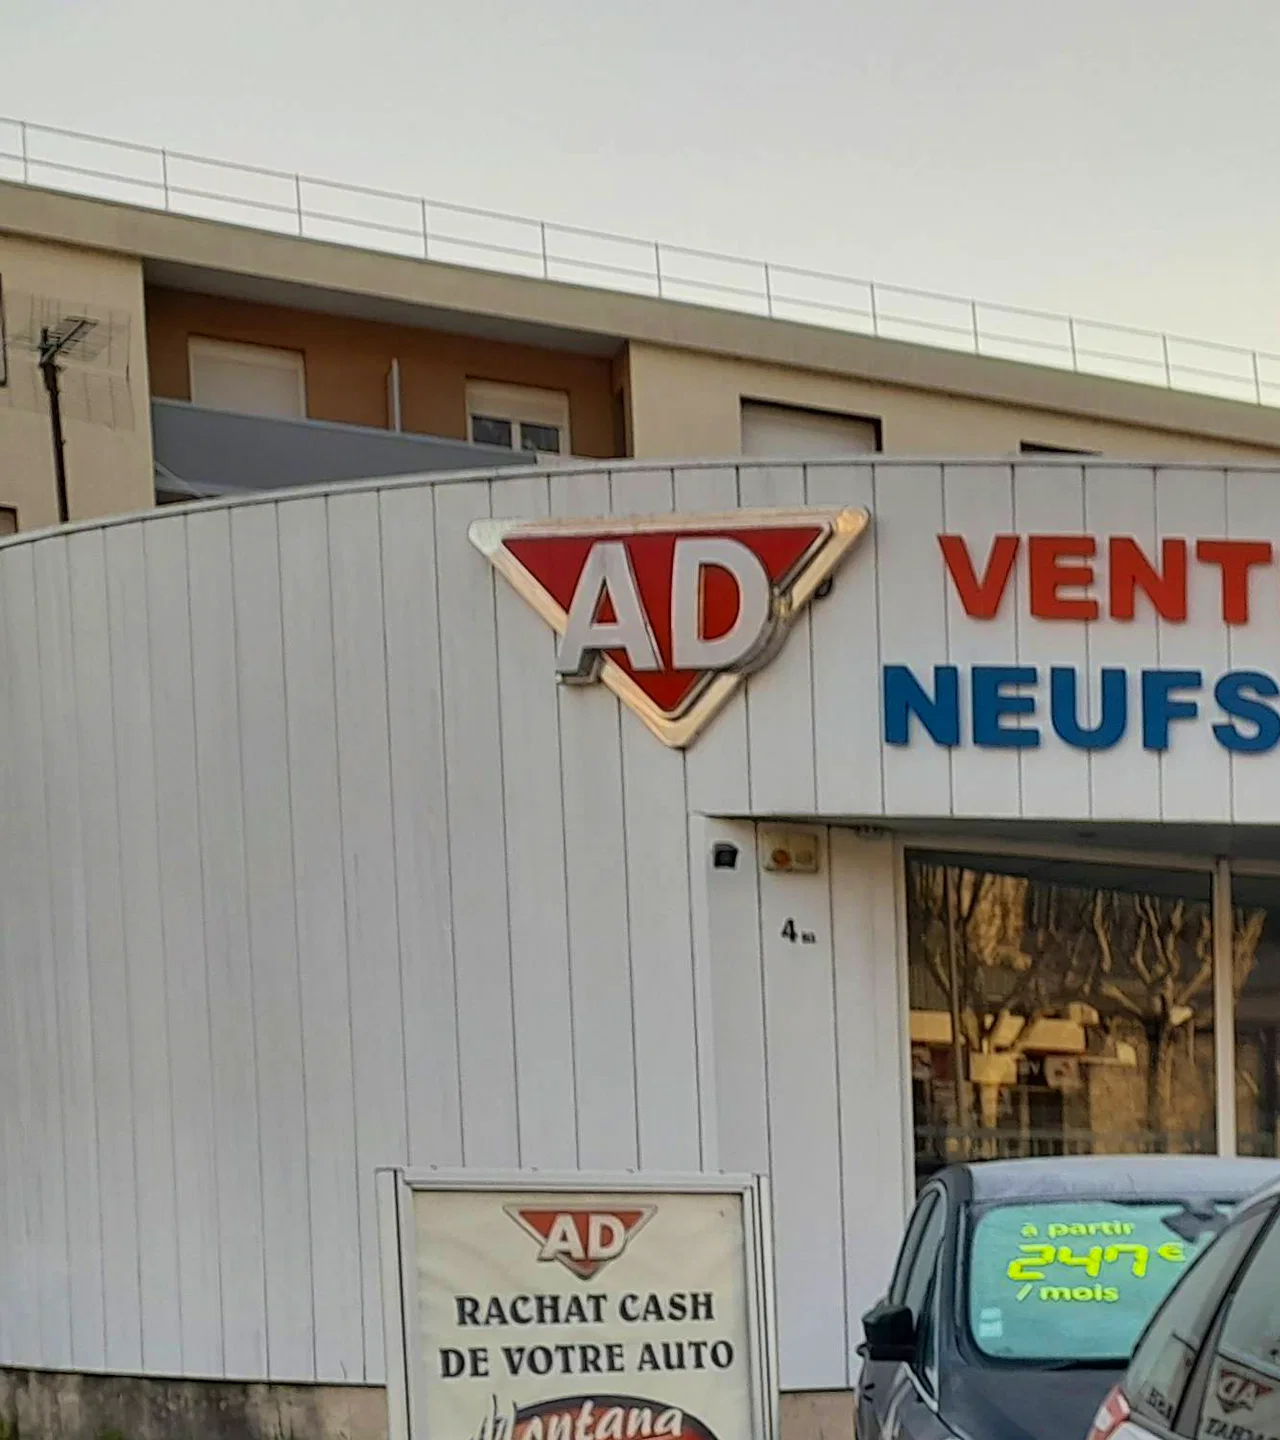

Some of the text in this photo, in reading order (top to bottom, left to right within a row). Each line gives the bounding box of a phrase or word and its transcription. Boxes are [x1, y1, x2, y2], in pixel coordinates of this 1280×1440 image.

[556, 535, 773, 675] AD
[782, 918, 798, 943] 4
[538, 1212, 626, 1262] AD
[1047, 1219, 1135, 1239] partir
[455, 1292, 715, 1327] RACHAT CASH
[439, 1340, 734, 1379] DE VOTRE AUTO
